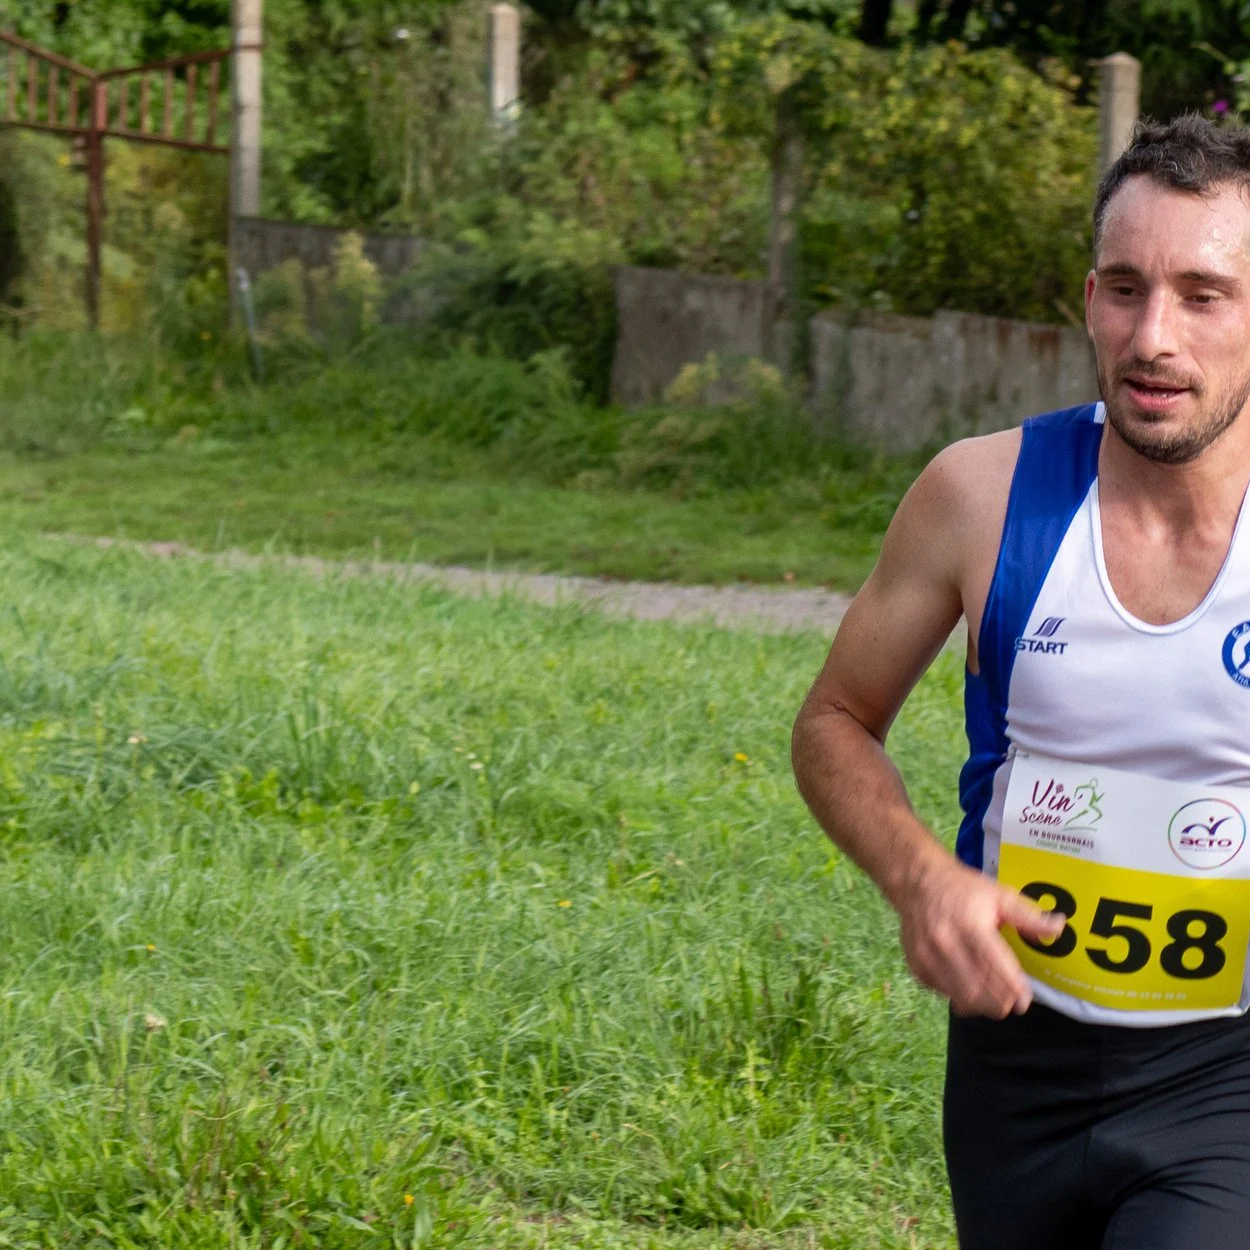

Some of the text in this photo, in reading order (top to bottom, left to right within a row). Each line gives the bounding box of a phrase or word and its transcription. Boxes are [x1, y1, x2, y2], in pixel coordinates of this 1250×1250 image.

[1014, 637, 1068, 655] START
[1041, 830, 1095, 850] BOURBONNAIS
[1017, 881, 1228, 980] 358
